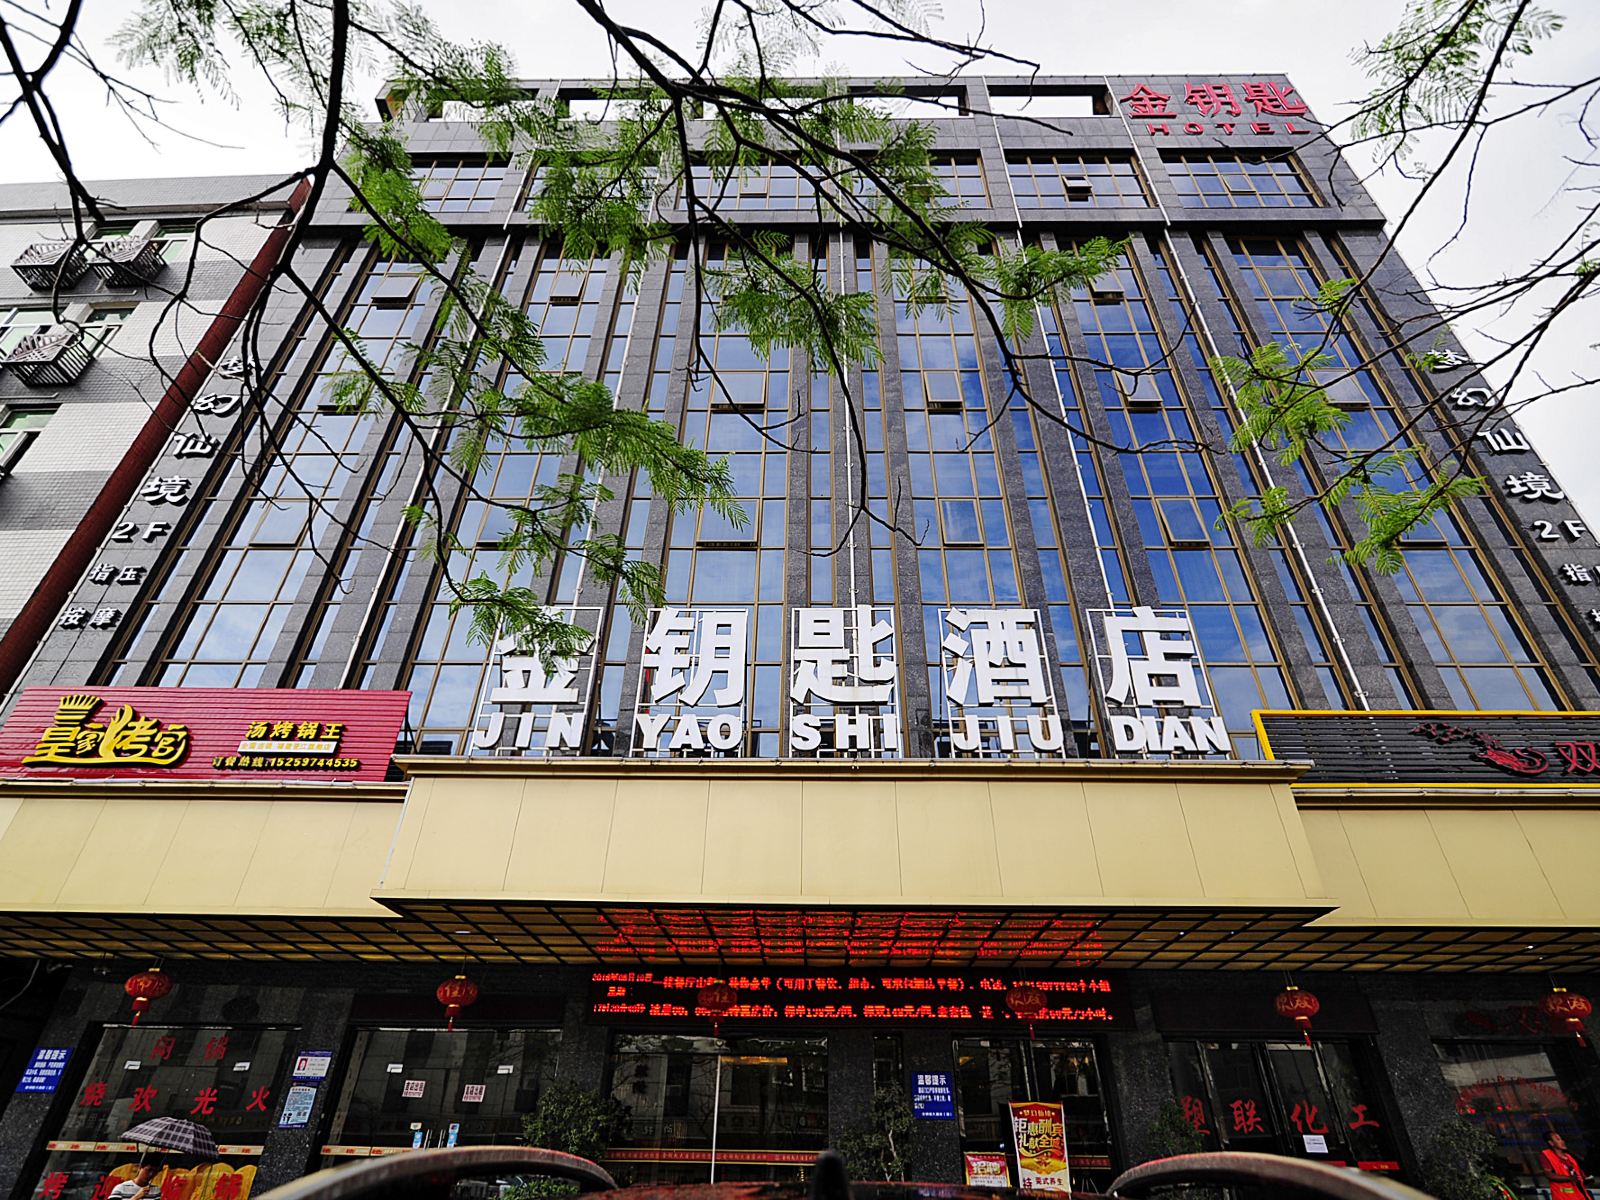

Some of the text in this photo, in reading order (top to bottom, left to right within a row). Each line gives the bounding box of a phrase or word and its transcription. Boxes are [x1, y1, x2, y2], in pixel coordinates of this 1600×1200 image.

[1120, 82, 1308, 118] 金钥匙
[1146, 122, 1310, 135] HOTEL
[111, 522, 169, 541] 2F
[1534, 520, 1587, 539] 2F
[88, 563, 142, 582] 指压
[1563, 563, 1600, 582] 指
[58, 607, 119, 627] 按摩
[491, 604, 1201, 707] 金钥匙酒店
[245, 721, 344, 740] 汤烤锅王
[474, 712, 1232, 753] JIN YAO SHI JIU DIAN
[1014, 1116, 1063, 1137] 钜惠酬宾
